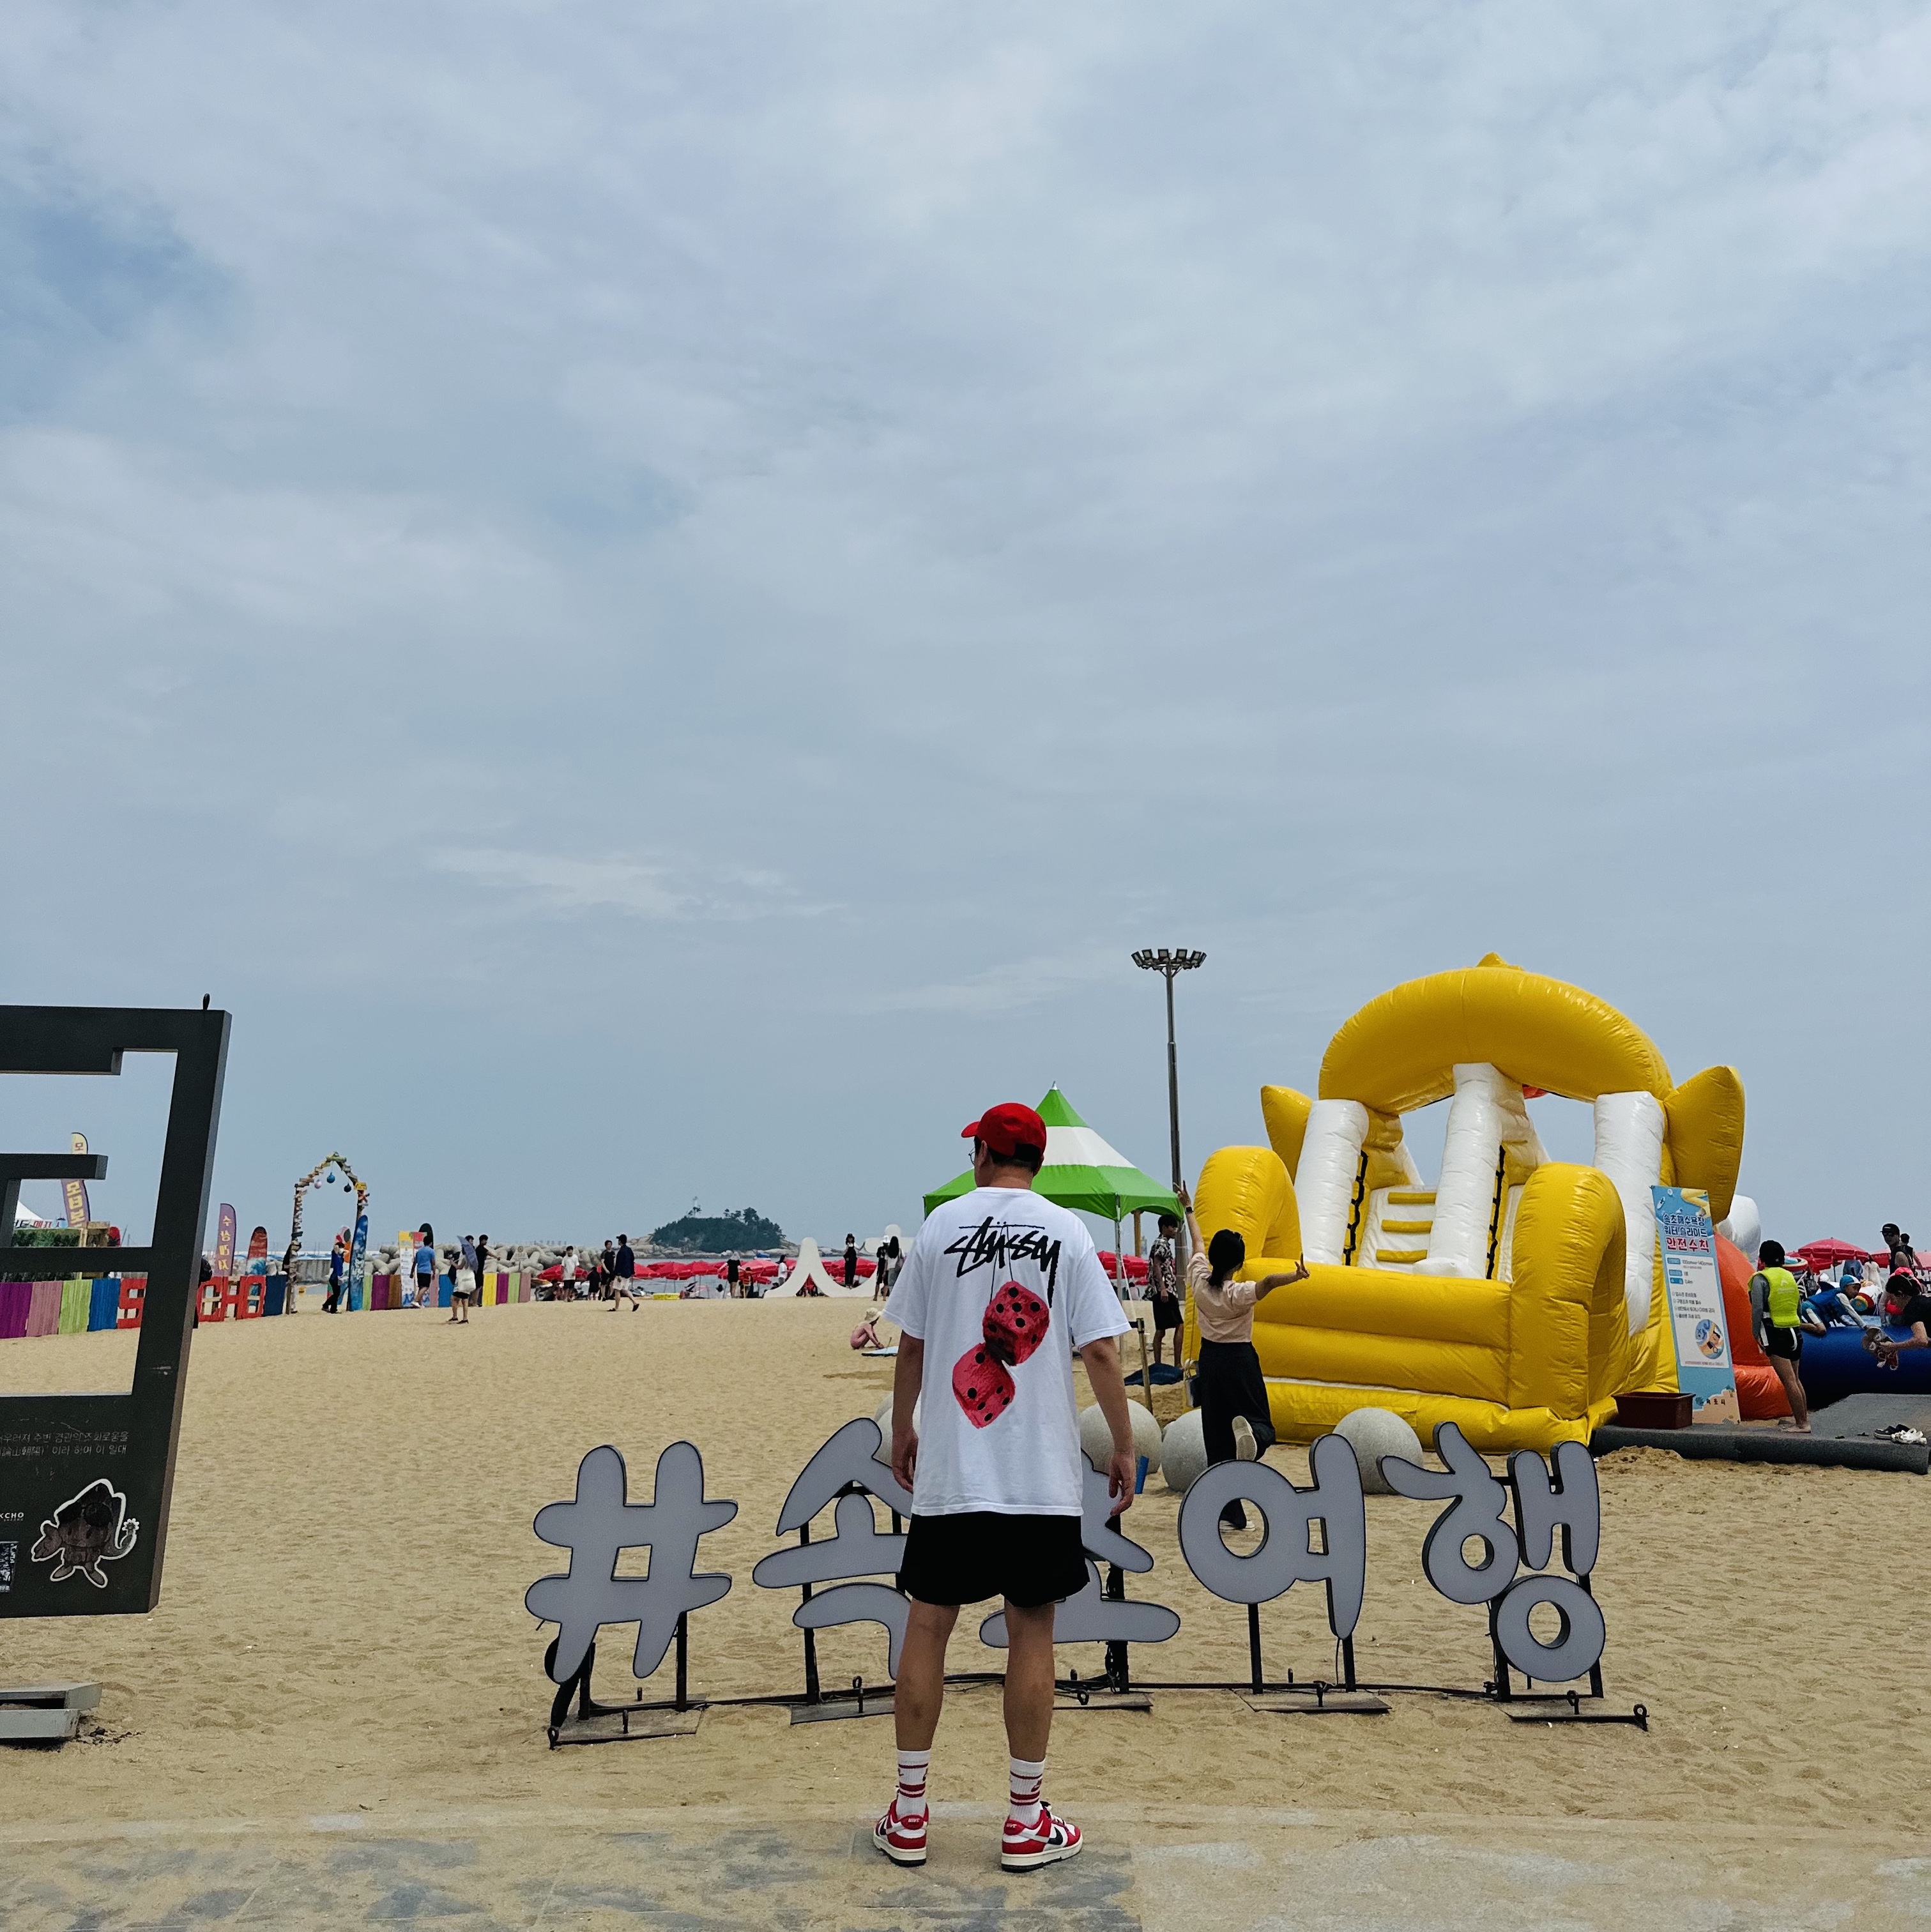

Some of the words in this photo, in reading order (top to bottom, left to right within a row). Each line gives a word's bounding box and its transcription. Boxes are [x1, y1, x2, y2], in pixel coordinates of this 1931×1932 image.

[1663, 1214, 1704, 1226] 속초해수욕장
[1664, 1226, 1678, 1235] 워터
[1666, 1237, 1709, 1252] 안전수칙
[52, 1445, 70, 1455] 이라
[74, 1445, 92, 1455] 하여
[96, 1445, 105, 1454] 이
[109, 1445, 127, 1455] 일대
